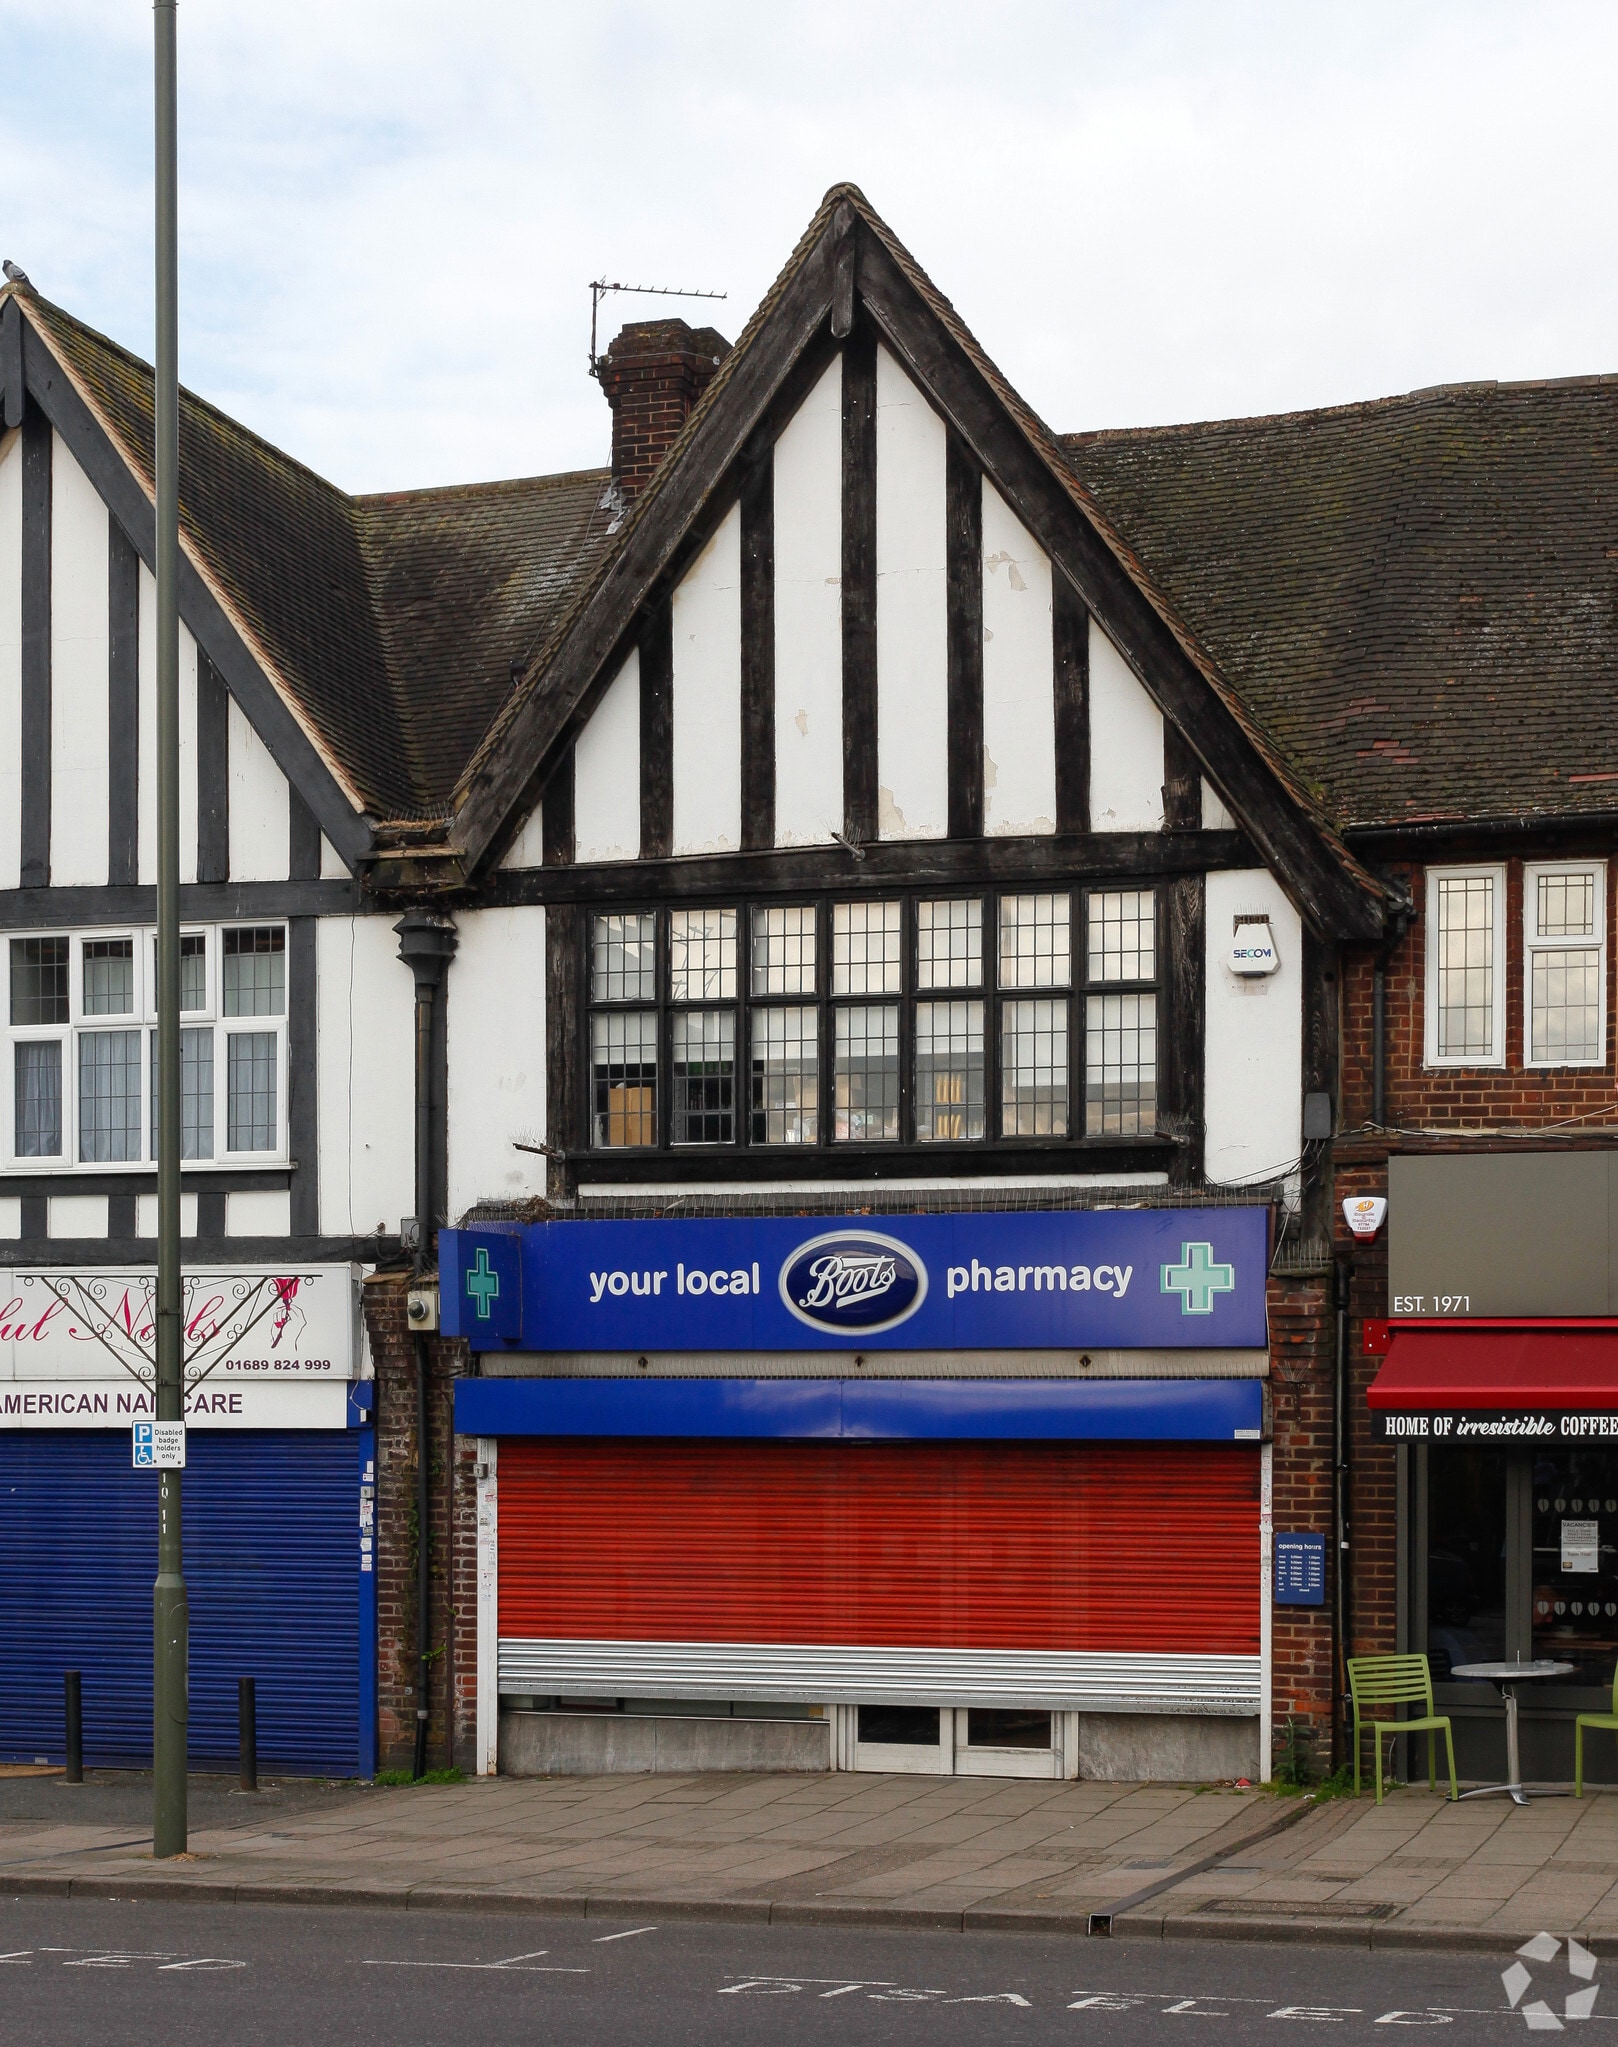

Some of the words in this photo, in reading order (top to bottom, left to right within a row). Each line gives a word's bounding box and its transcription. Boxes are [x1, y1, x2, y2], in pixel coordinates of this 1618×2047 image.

[1233, 948, 1271, 958] SECOM
[589, 1271, 667, 1303] your
[677, 1262, 760, 1295] local
[798, 1255, 896, 1308] Boots
[947, 1258, 1133, 1299] pharmacy
[1394, 1296, 1426, 1312] EST.
[1432, 1295, 1471, 1312] 1971
[225, 1360, 269, 1371] 01689
[273, 1360, 300, 1371] 824
[304, 1360, 331, 1371] 999
[116, 1393, 155, 1413] NAI
[1385, 1416, 1429, 1436] HOME
[1433, 1416, 1453, 1436] OF
[1456, 1415, 1556, 1436] irresistible
[1560, 1416, 1618, 1436] COFFEE
[1278, 1543, 1303, 1551] opening
[716, 1982, 1454, 2025] DISABLED
